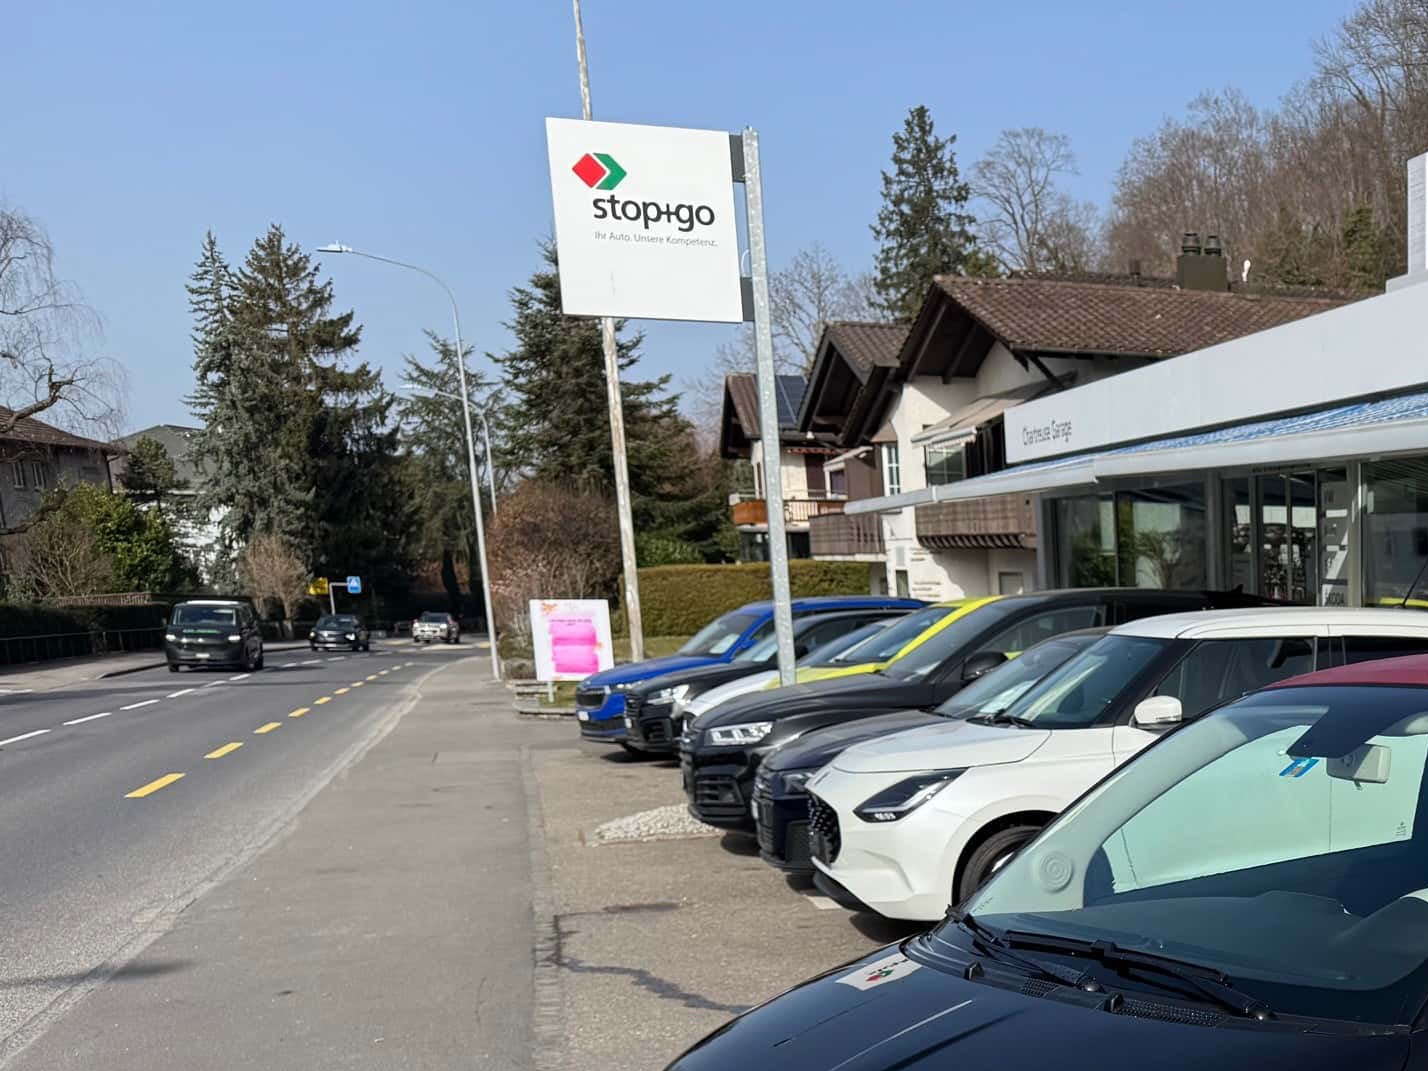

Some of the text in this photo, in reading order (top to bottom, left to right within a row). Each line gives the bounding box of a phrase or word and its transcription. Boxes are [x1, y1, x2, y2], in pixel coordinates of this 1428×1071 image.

[593, 194, 715, 232] stop+go
[594, 231, 606, 240] Ihr
[633, 234, 664, 243] Unsere
